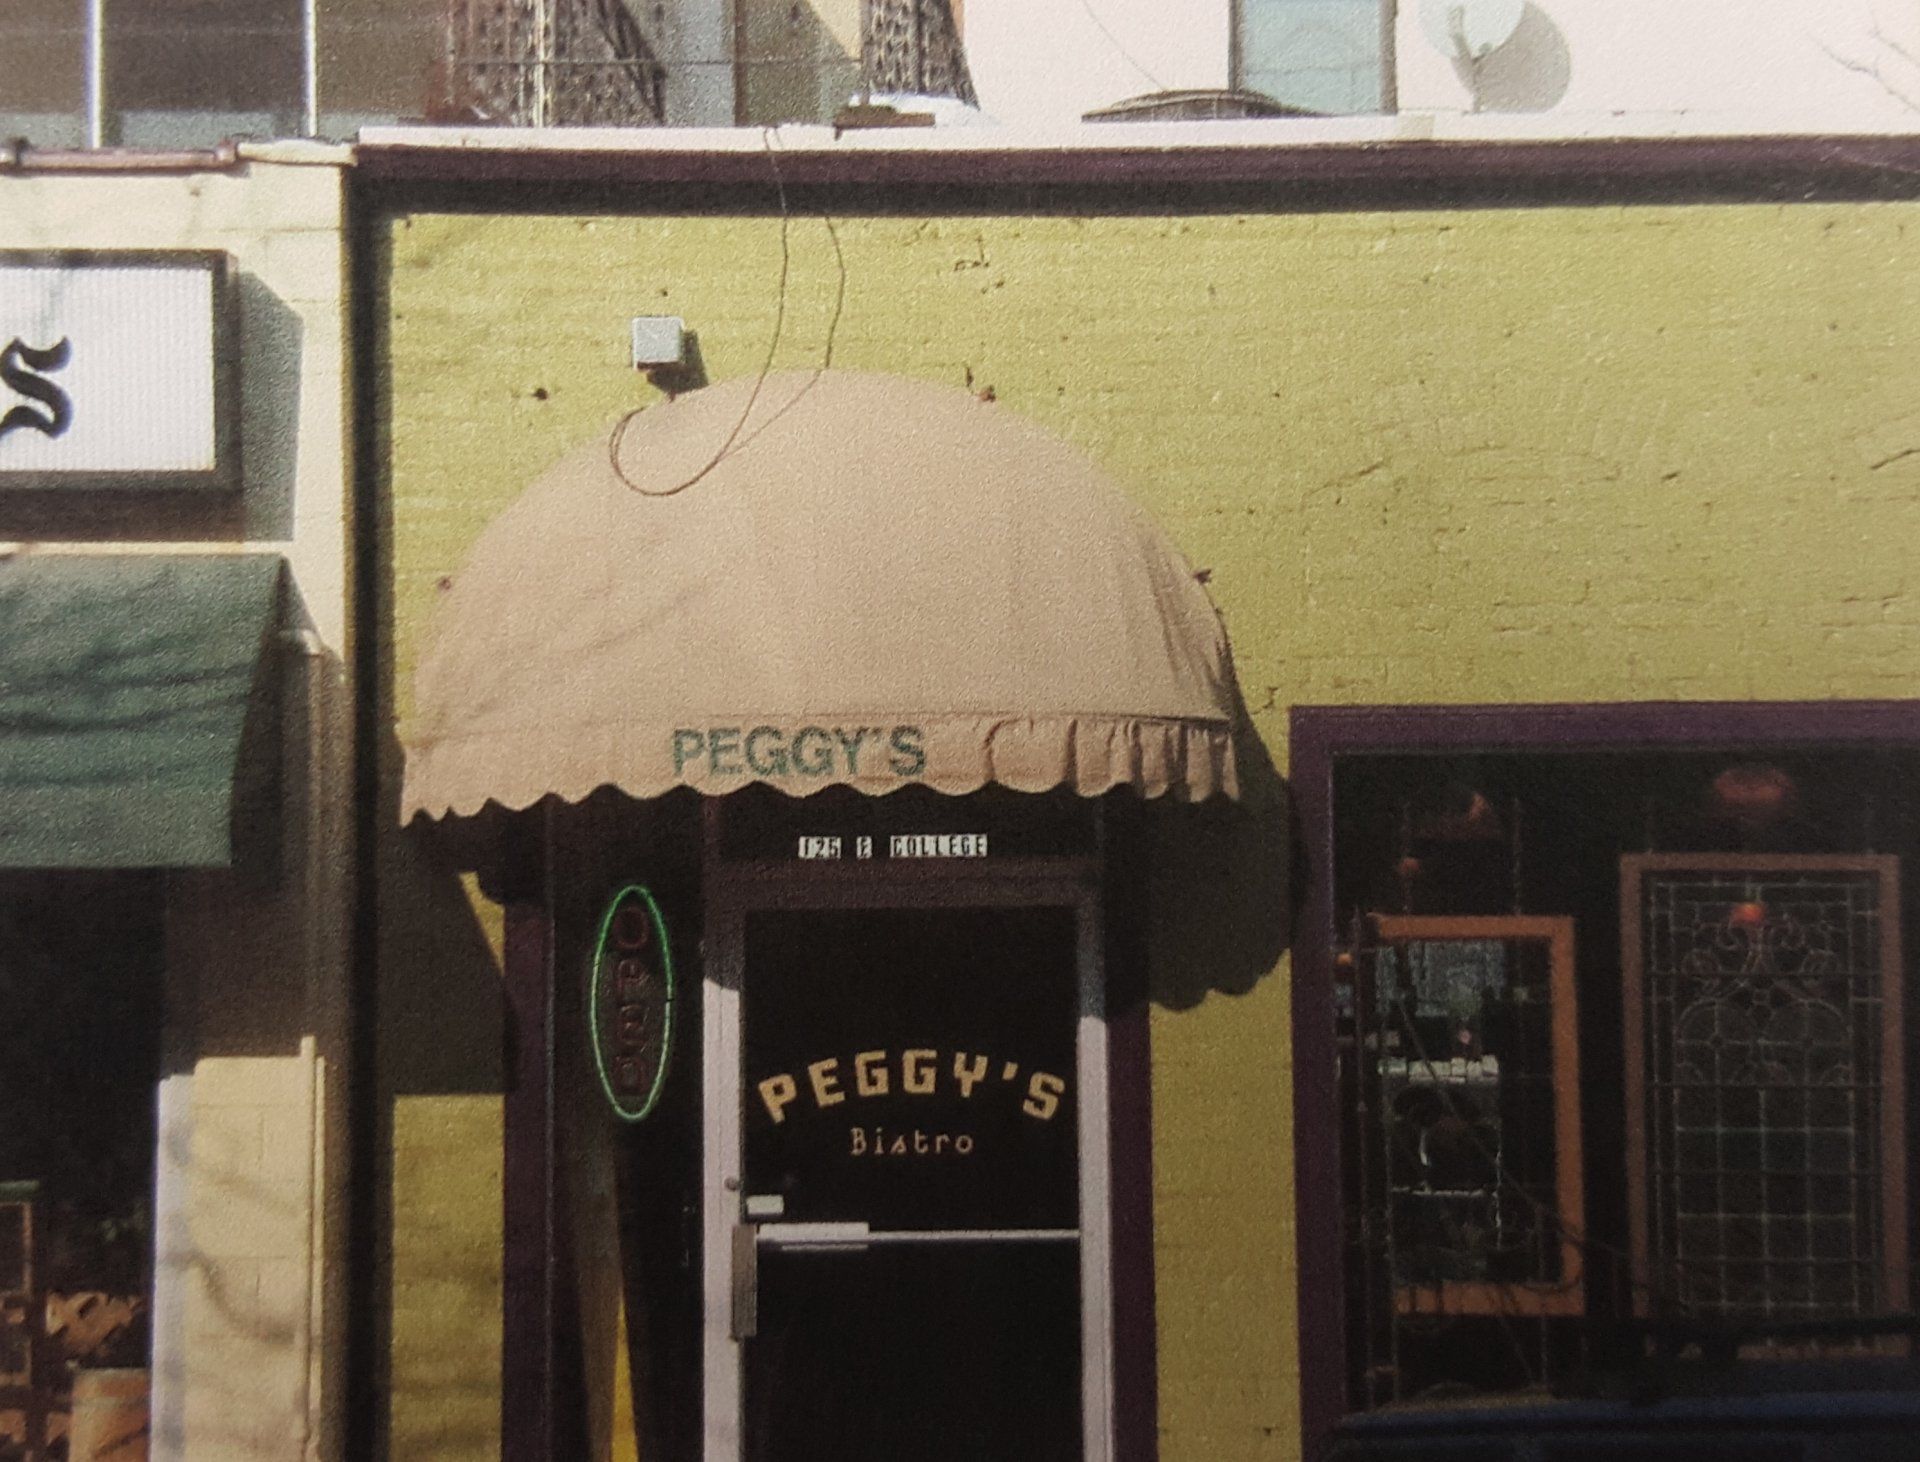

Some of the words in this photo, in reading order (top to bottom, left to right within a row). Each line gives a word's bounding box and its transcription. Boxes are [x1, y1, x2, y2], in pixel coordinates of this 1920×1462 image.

[674, 724, 927, 778] PEGGY'S
[798, 835, 842, 860] 125
[890, 834, 988, 858] COLLEGE
[758, 1049, 1066, 1124] PEGGY'S
[850, 1126, 975, 1155] Bistro
